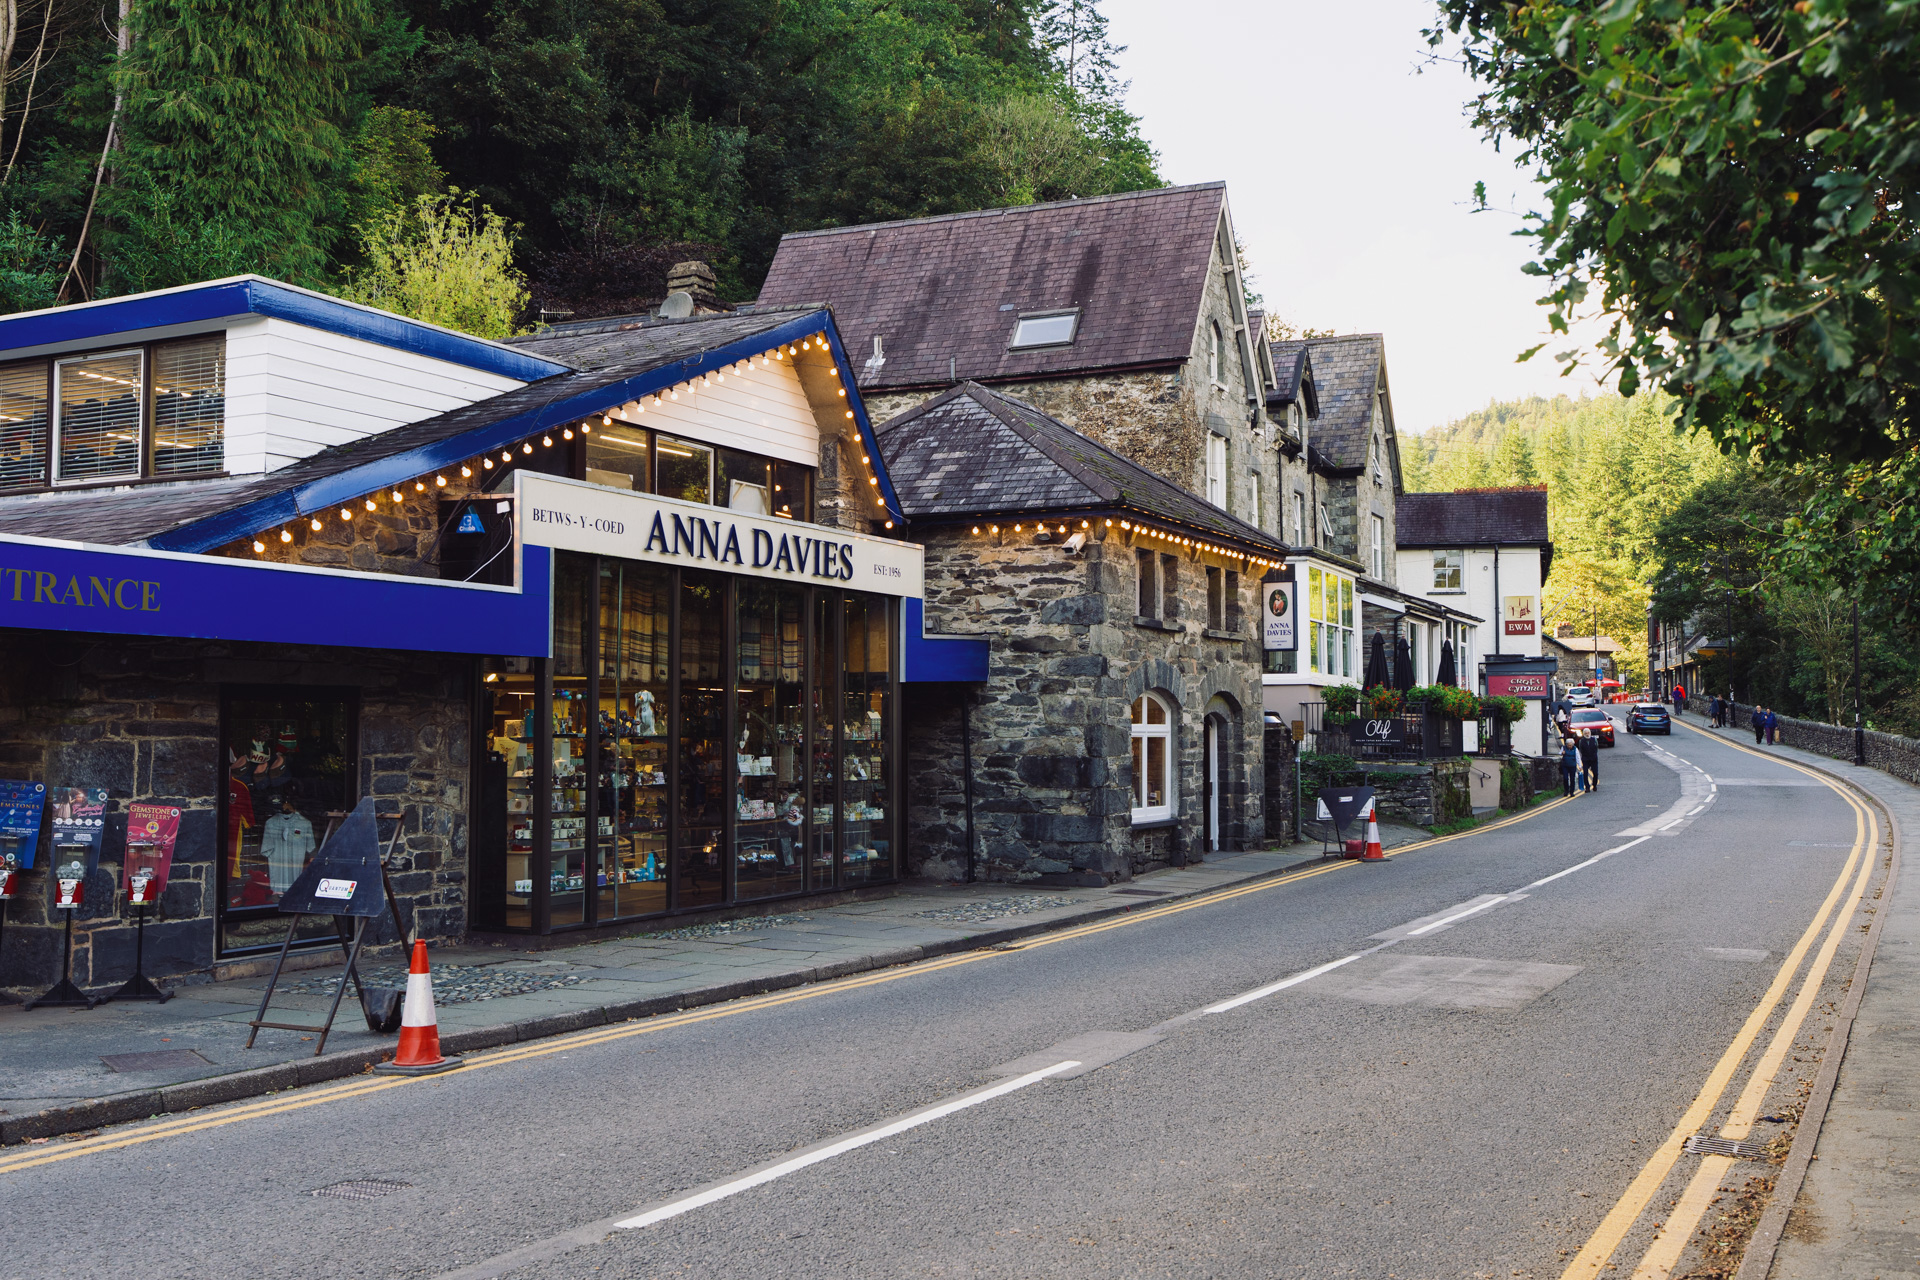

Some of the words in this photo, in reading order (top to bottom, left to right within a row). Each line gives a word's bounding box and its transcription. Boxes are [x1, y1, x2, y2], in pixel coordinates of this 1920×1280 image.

[644, 509, 744, 566] ANNA
[751, 527, 854, 581] DAVIES
[888, 566, 902, 578] 1956
[0, 568, 162, 612] TRANCE
[1508, 623, 1532, 631] EWM
[1365, 719, 1392, 740] Olif
[0, 801, 40, 809] EMSTONES
[130, 804, 171, 815] GEMSTONE
[135, 812, 171, 820] JEWELLERY
